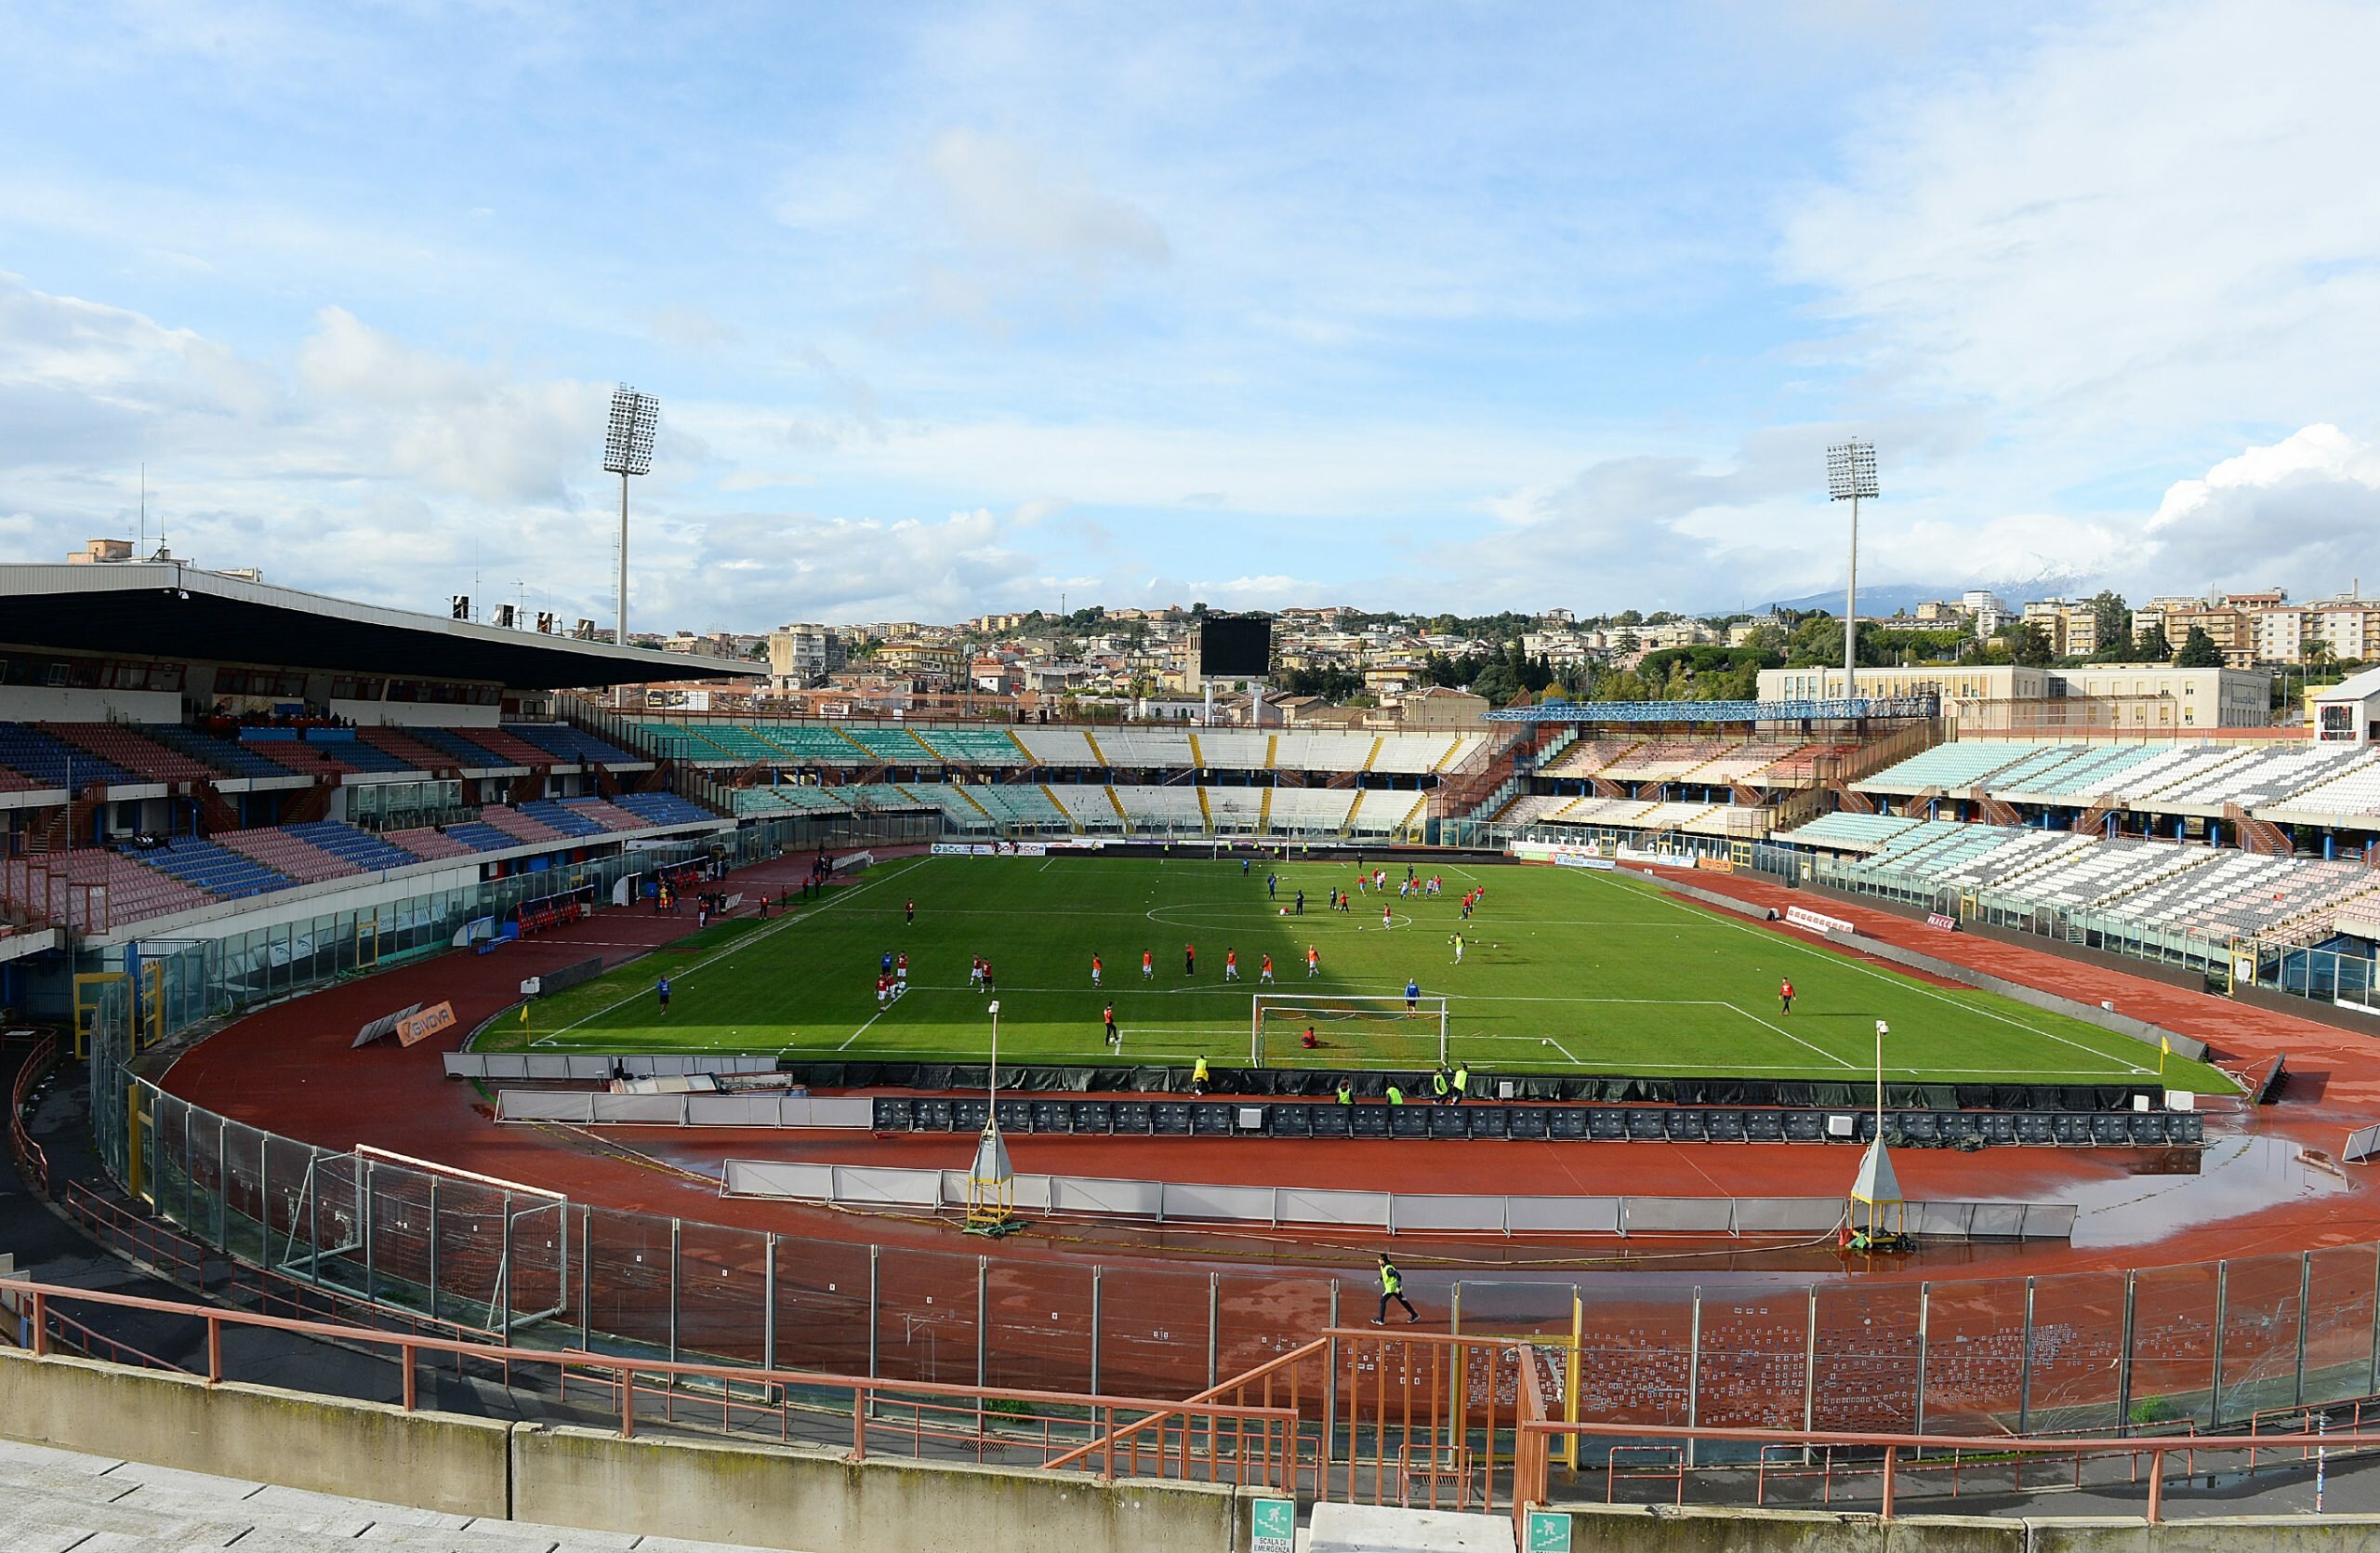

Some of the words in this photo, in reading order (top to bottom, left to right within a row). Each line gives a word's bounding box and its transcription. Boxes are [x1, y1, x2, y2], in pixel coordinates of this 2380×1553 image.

[1646, 843, 1729, 861] CATANIA
[413, 1008, 450, 1036] GIVOVA
[1259, 1537, 1279, 1546] SCALA
[1253, 1545, 1290, 1553] EMERGENZA
